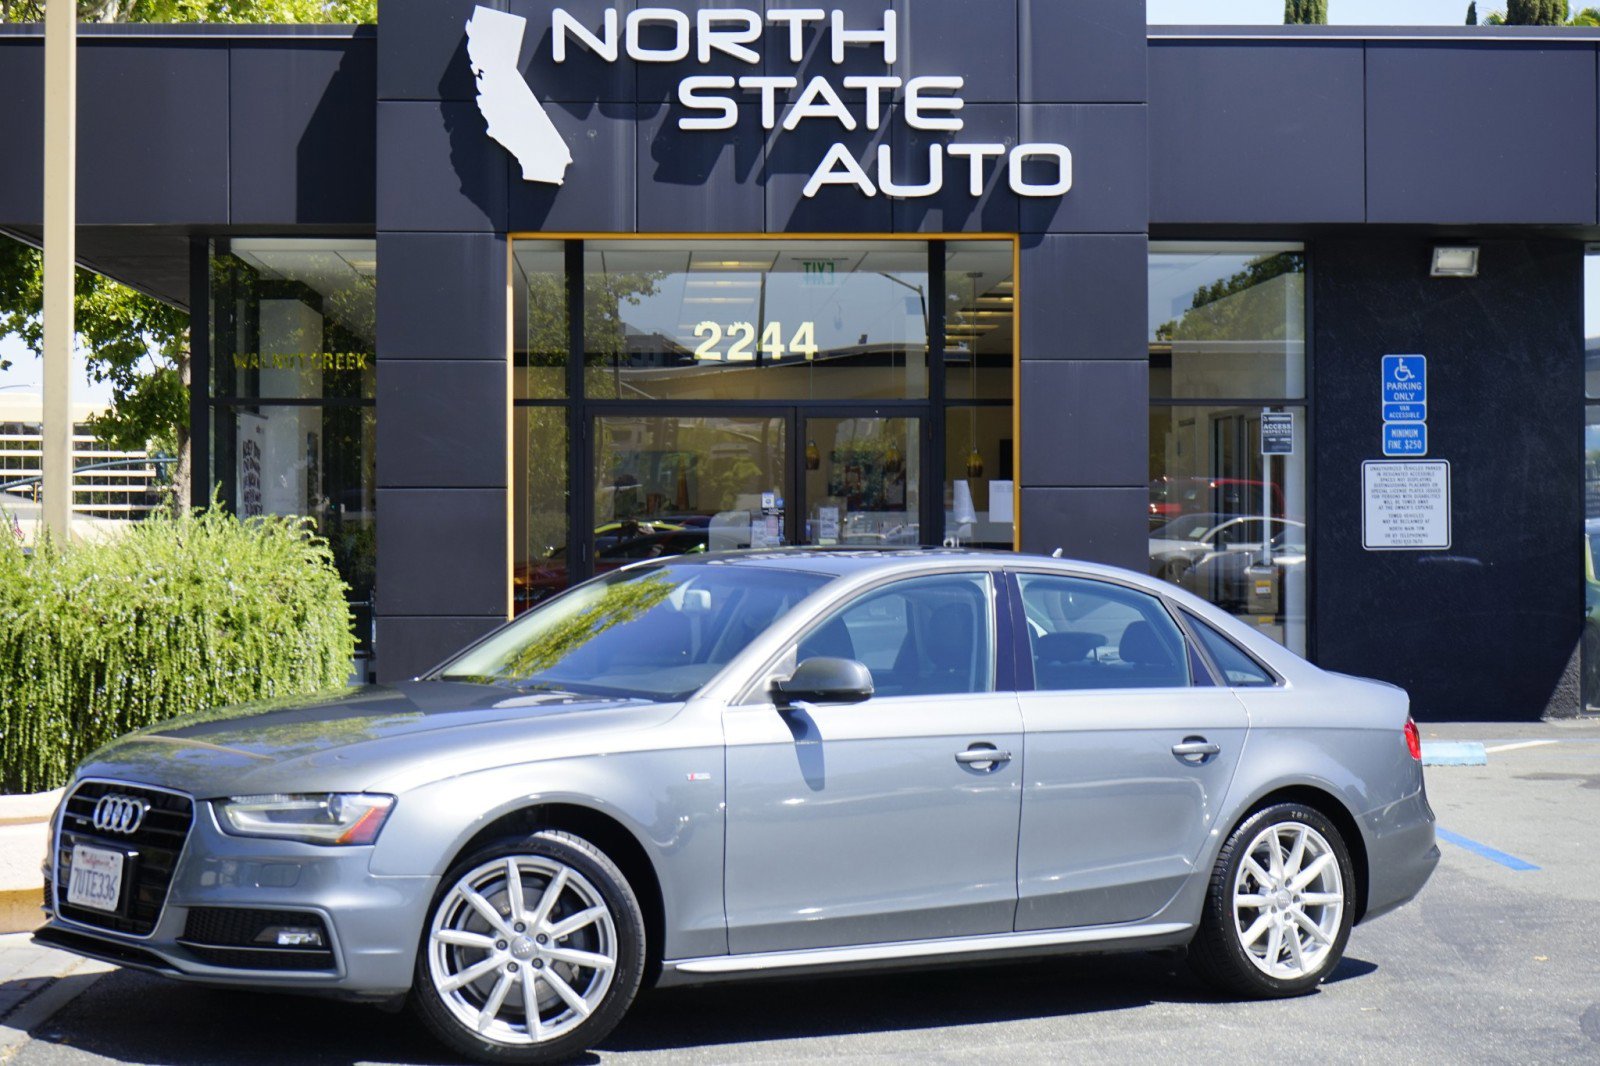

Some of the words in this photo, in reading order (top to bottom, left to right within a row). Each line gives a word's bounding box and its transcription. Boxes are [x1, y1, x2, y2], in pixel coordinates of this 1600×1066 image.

[552, 7, 897, 64] NORTH
[678, 75, 964, 131] STATE
[802, 143, 1073, 198] AUTO
[693, 320, 819, 361] 2244
[232, 352, 304, 370] WALNUT
[310, 352, 368, 370] CREEK
[1386, 382, 1422, 390] PARKING
[1394, 392, 1415, 400] ONLY
[1388, 440, 1401, 449] FINE
[1404, 440, 1422, 450] $250
[1392, 429, 1418, 438] MINIMUM
[73, 867, 118, 901] 7UTE336
